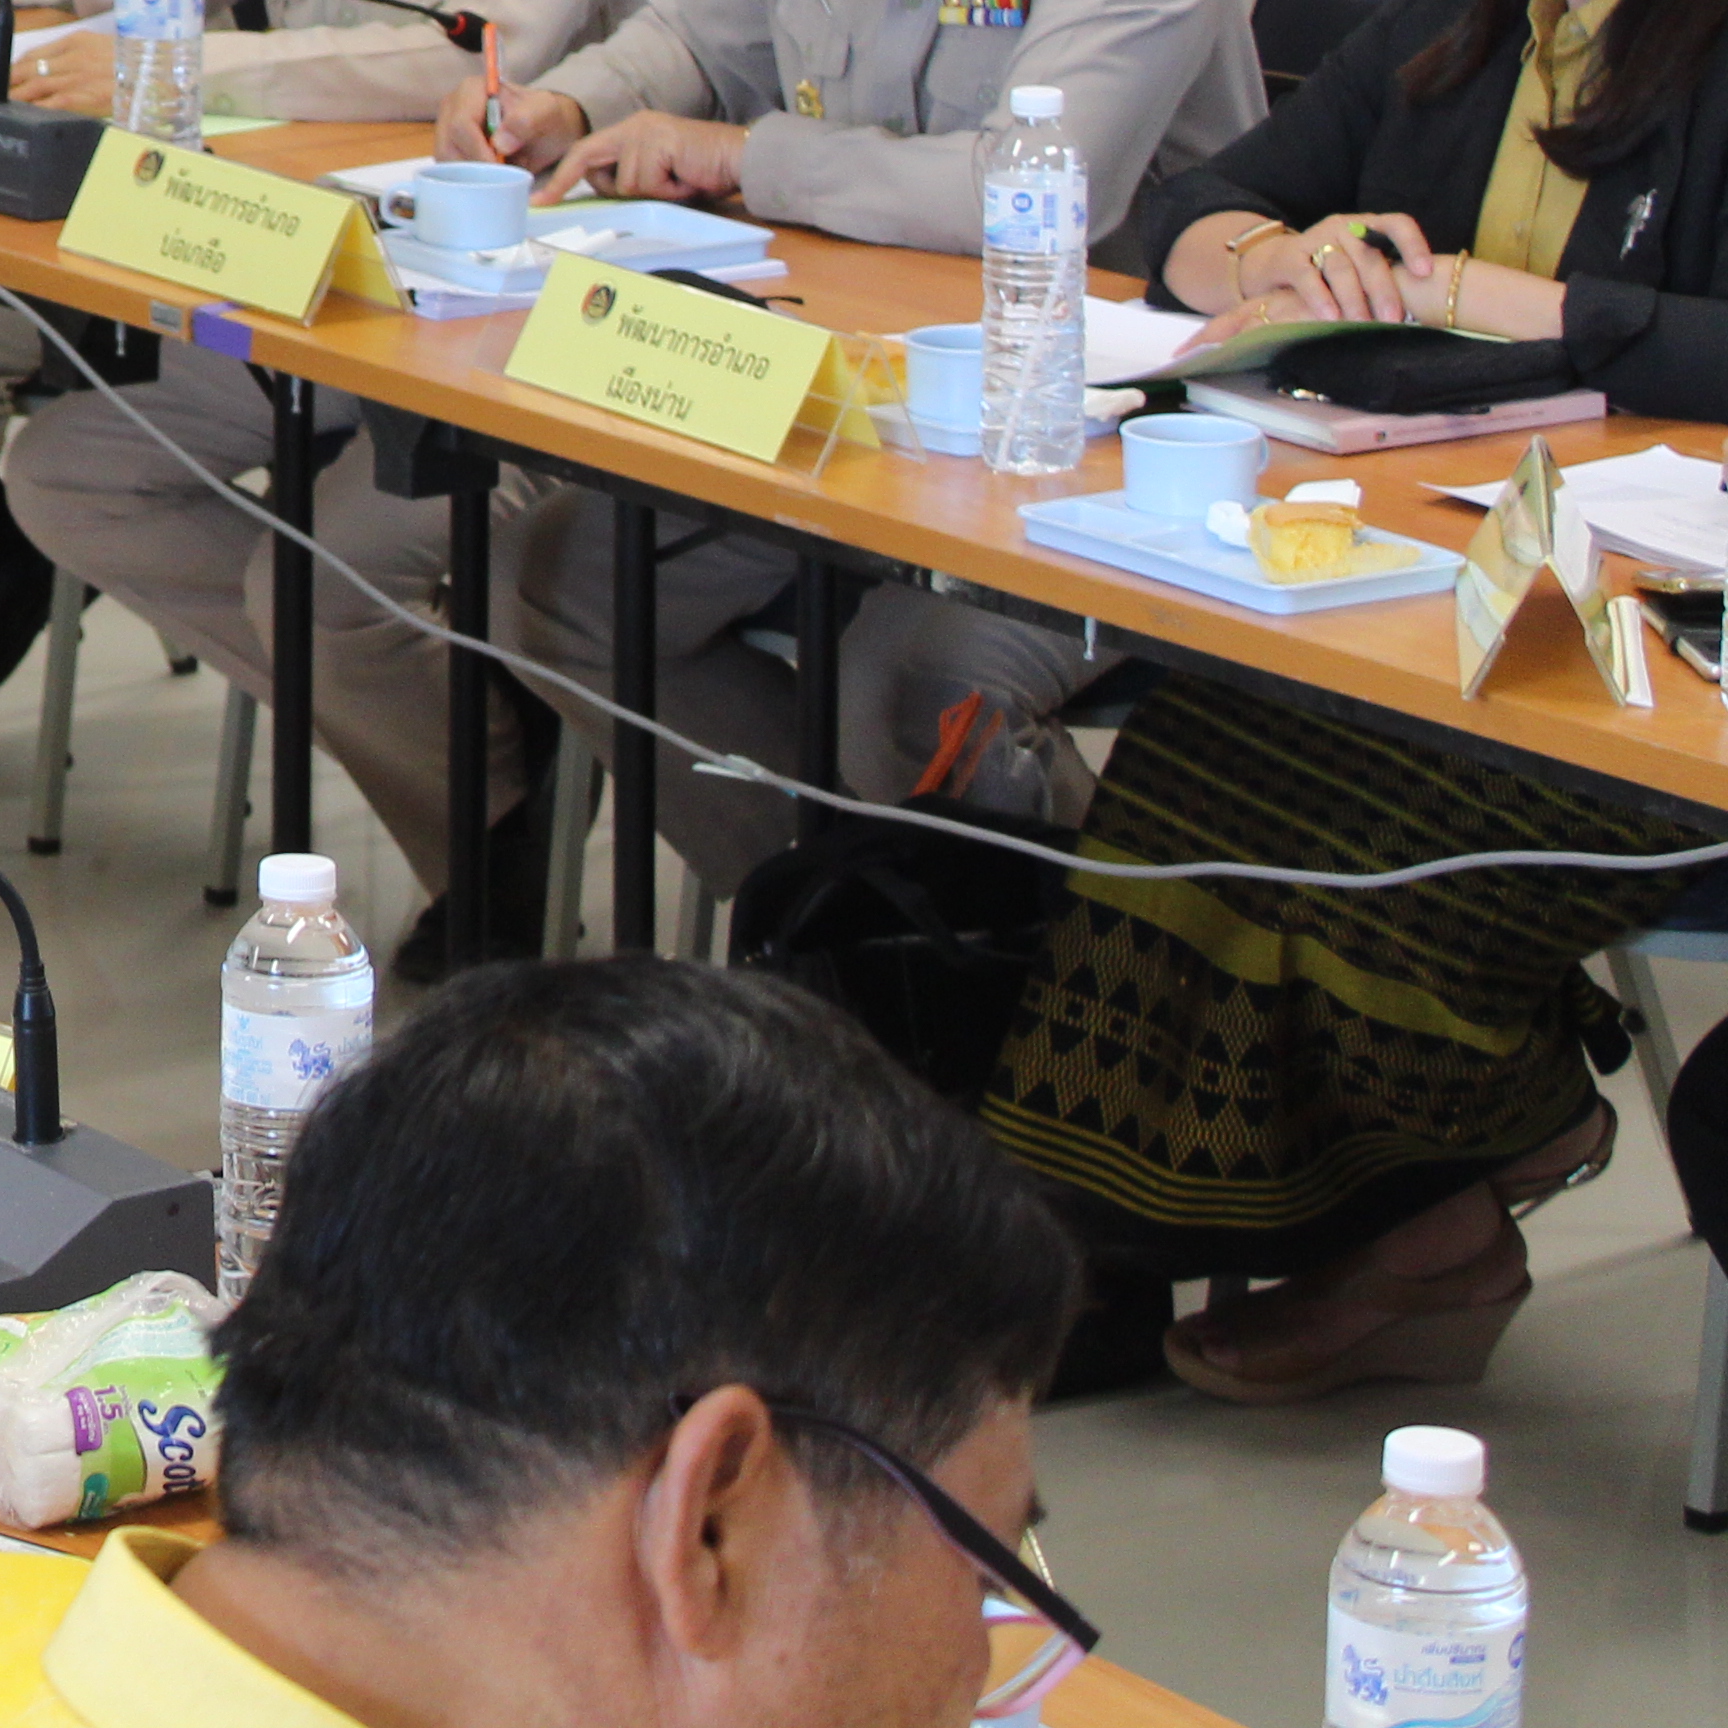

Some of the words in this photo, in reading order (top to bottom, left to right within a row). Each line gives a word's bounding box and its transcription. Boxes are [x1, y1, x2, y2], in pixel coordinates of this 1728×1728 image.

[165, 168, 301, 237] พัฒนาการอำเภอ
[615, 304, 770, 380] พัฒนาการอำเภอ
[605, 368, 692, 420] เมืองน่าน
[137, 1399, 207, 1494] Scot
